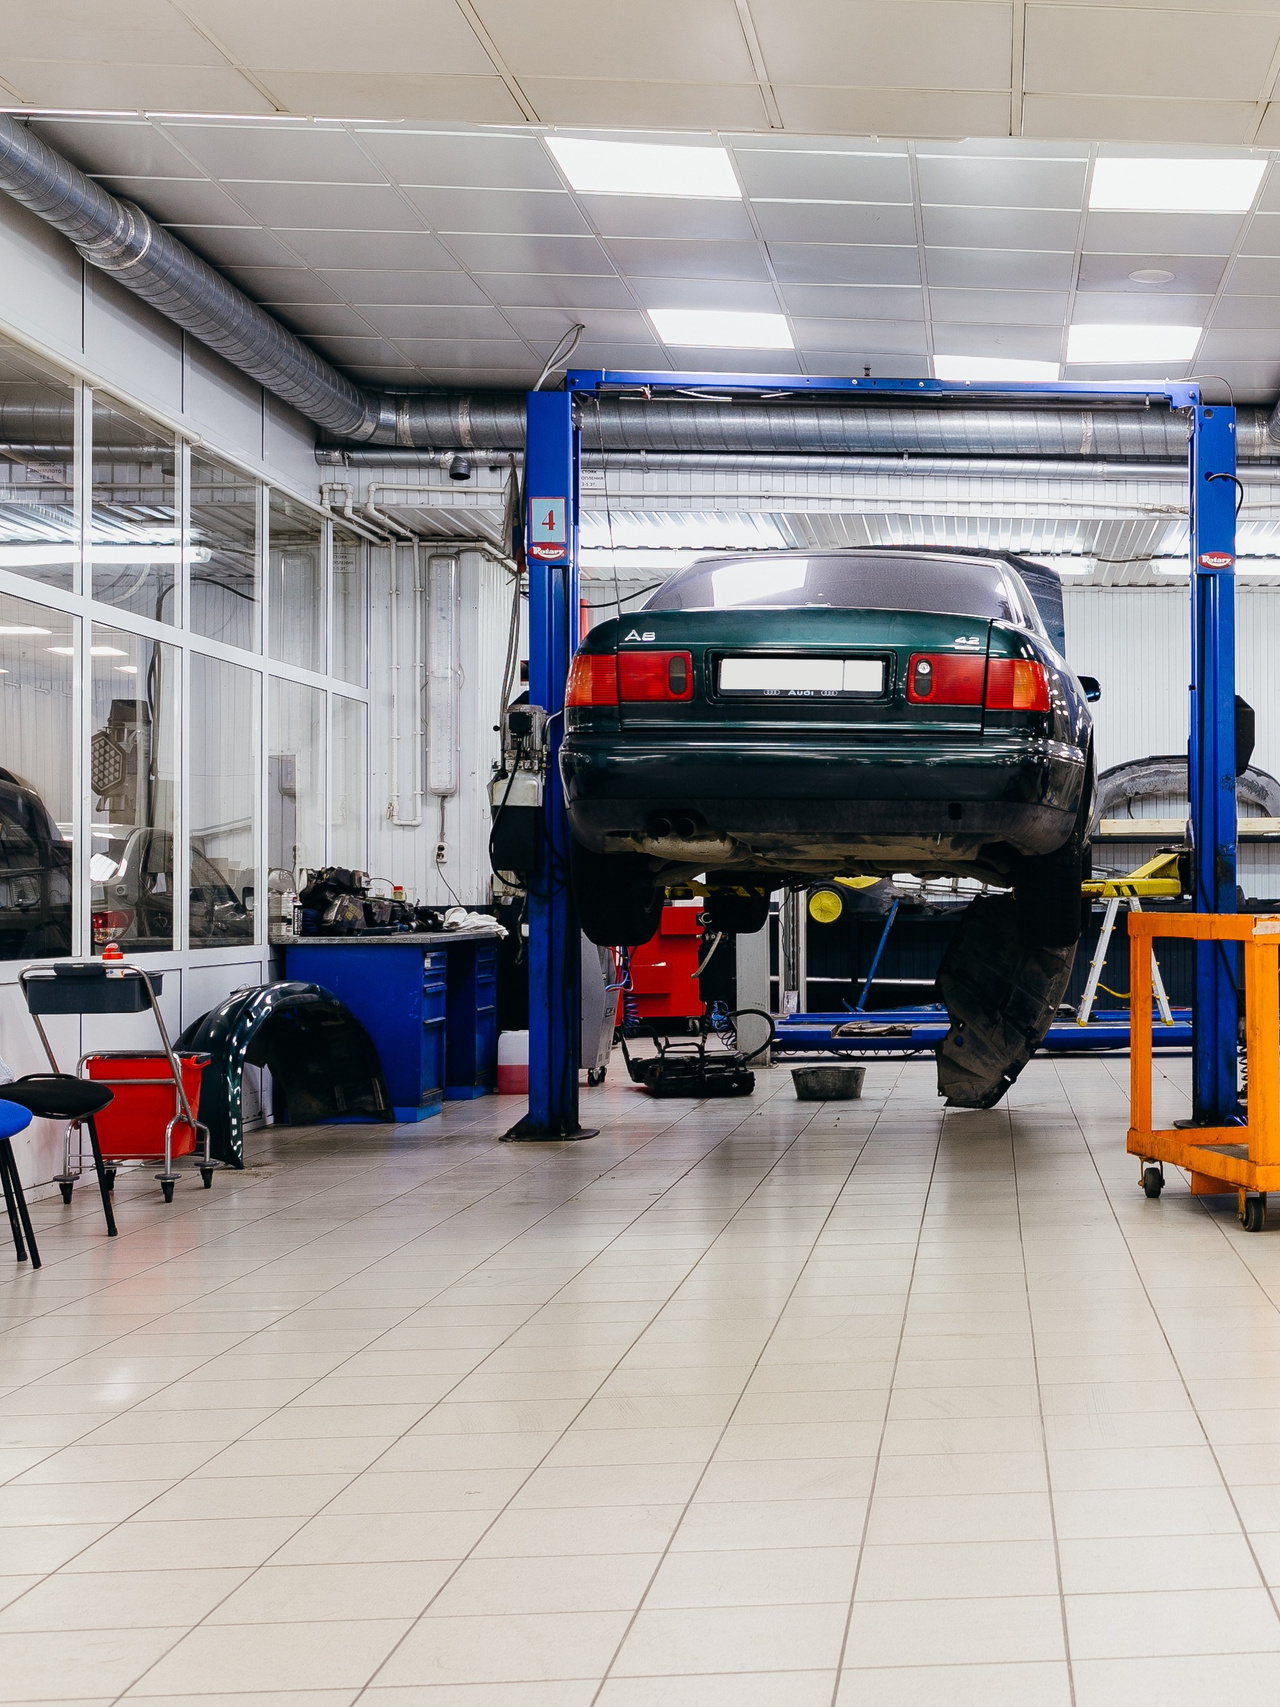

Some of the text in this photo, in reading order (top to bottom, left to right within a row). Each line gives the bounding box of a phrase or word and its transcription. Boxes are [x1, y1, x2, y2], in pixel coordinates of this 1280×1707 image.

[541, 509, 555, 531] 4
[532, 546, 564, 558] Rotary
[1201, 555, 1232, 567] Rotary
[624, 629, 656, 641] A8
